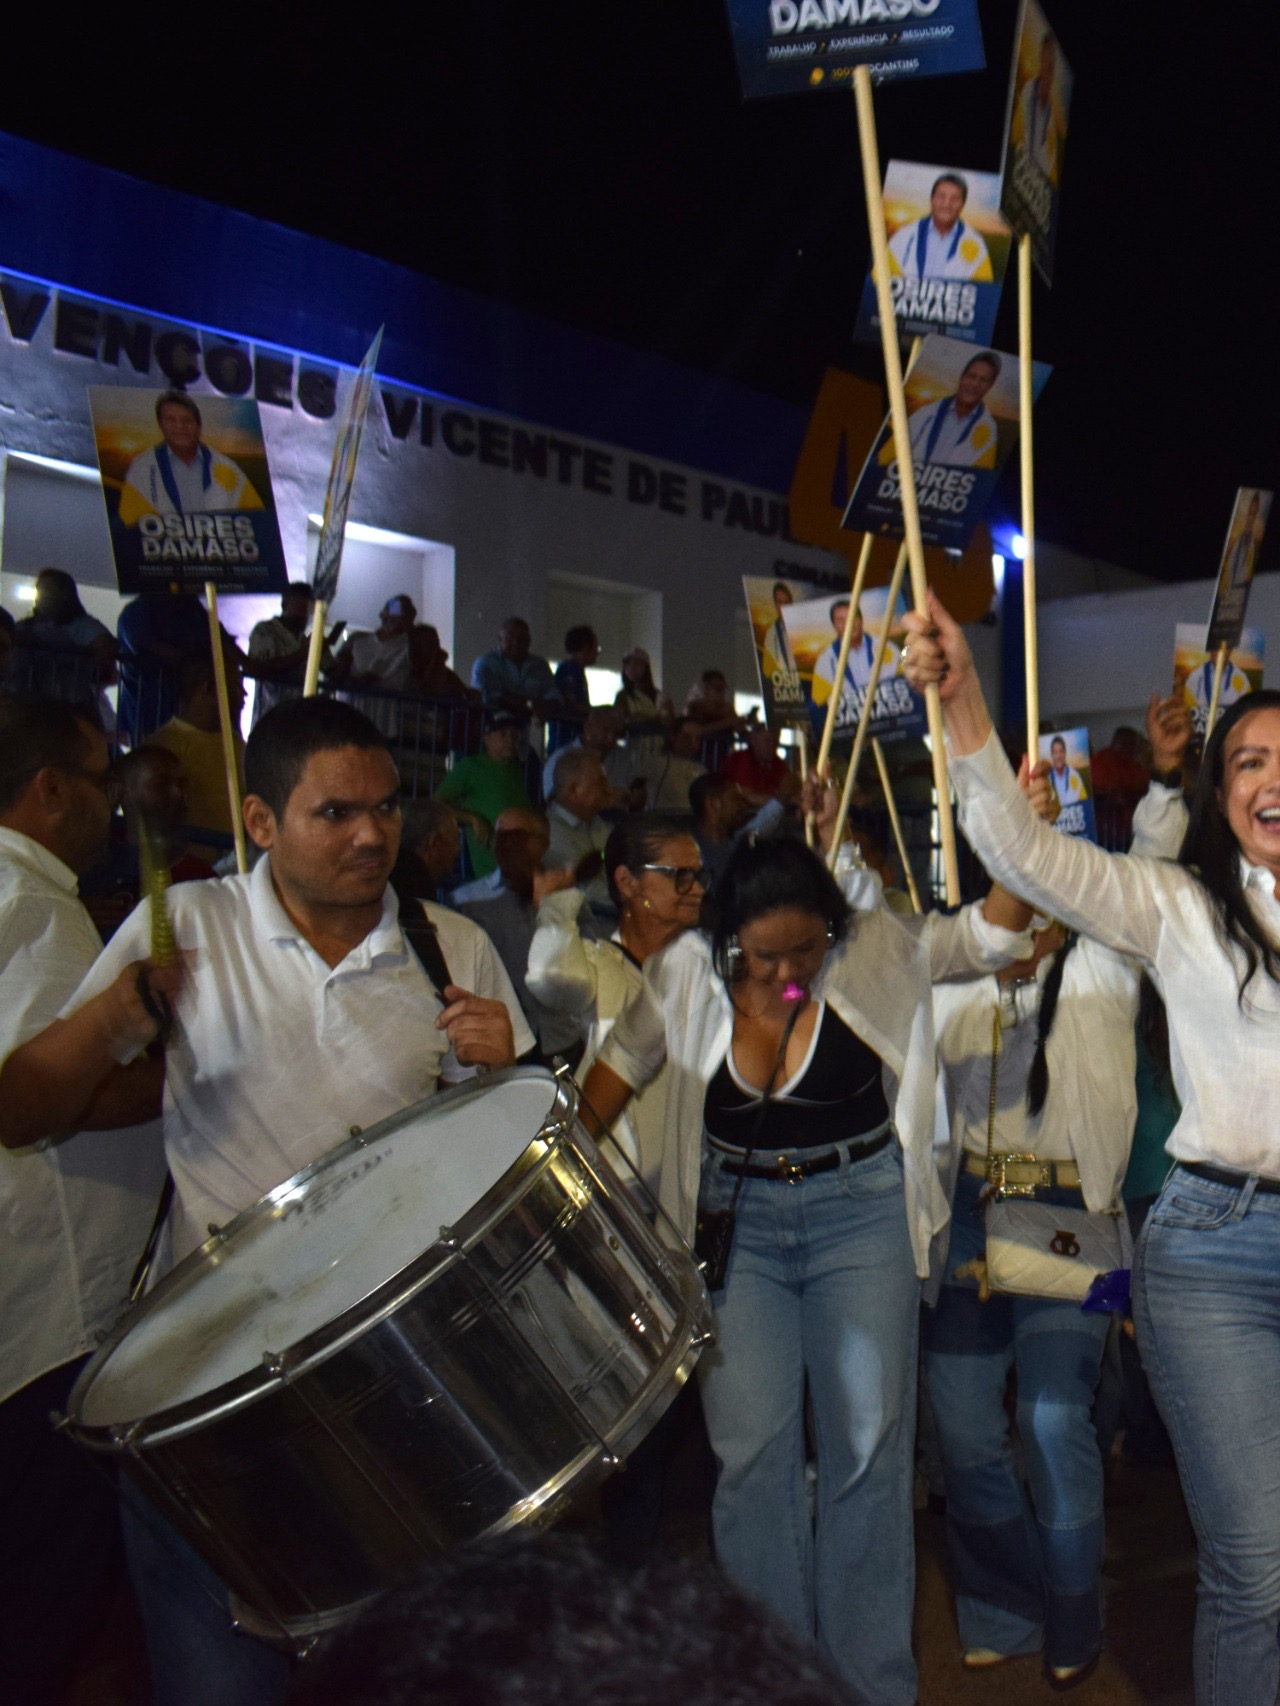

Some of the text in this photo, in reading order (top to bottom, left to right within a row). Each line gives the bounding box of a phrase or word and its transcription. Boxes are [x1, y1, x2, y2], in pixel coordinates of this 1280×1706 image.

[768, 24, 956, 58] TRABALHO EXPERIÊNCIA RESULTADO
[380, 392, 616, 497] VICENTE
[627, 459, 687, 516] DE
[138, 513, 256, 541] OSIRES
[141, 536, 260, 564] DAMASO
